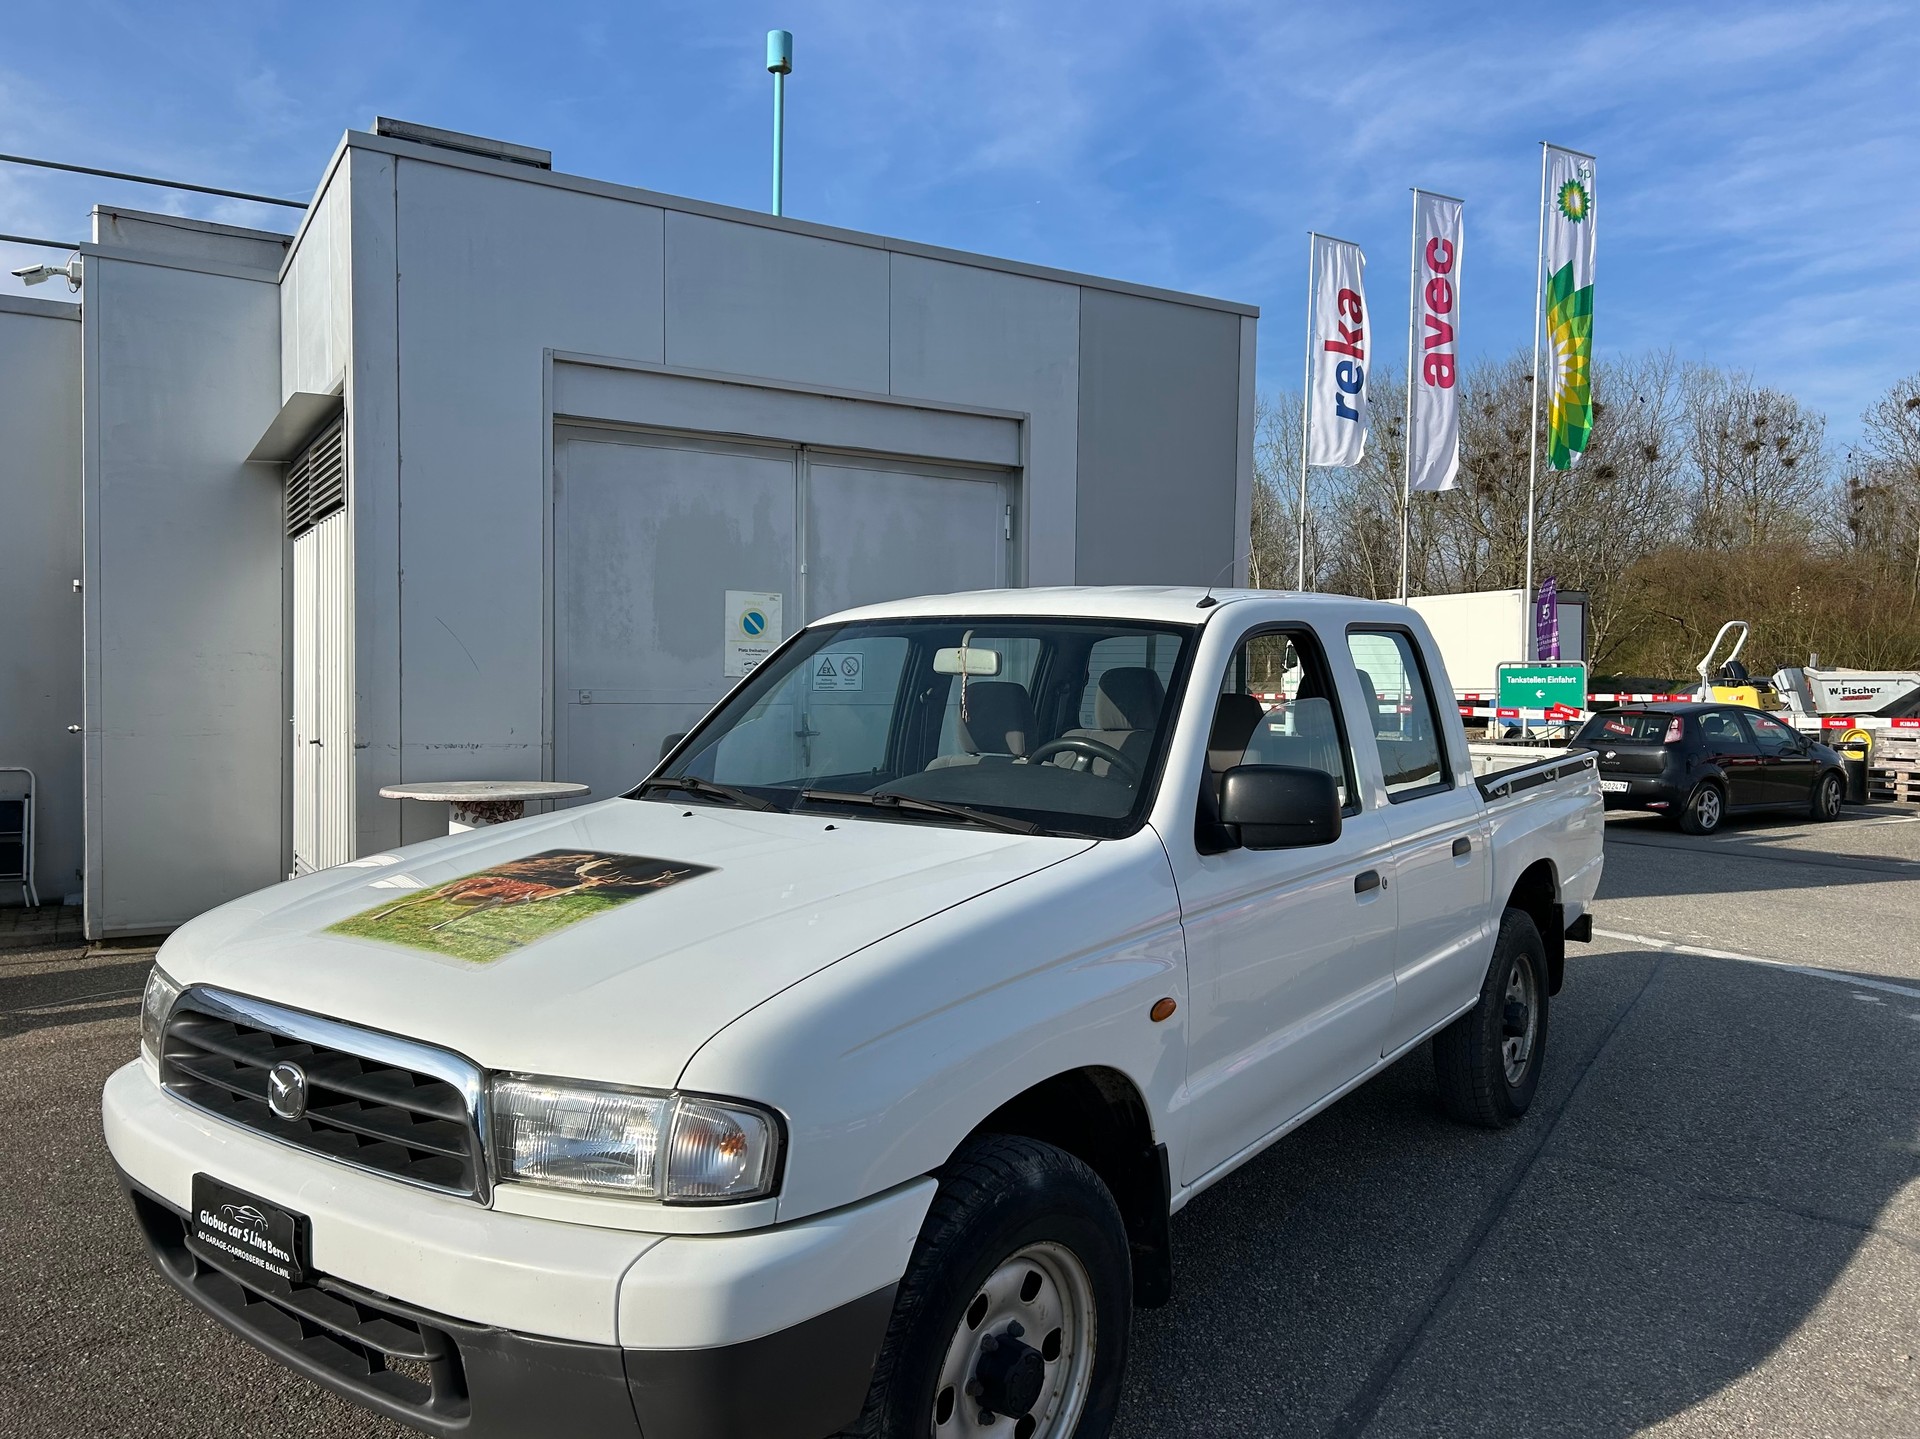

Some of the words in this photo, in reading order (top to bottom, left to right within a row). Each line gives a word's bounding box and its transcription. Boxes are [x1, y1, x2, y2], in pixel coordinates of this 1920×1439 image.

[1577, 164, 1592, 181] bp
[1423, 237, 1456, 389] avec
[1324, 288, 1365, 423] reka
[822, 666, 831, 674] EX
[1506, 676, 1546, 684] Tankstellen
[1547, 676, 1577, 684] Einfahrt
[1611, 723, 1625, 732] KIBAG
[200, 1210, 227, 1233] Globus
[228, 1224, 242, 1239] car
[243, 1228, 249, 1242] S
[249, 1230, 267, 1251] Line
[267, 1240, 290, 1262] Berro
[198, 1231, 205, 1240] AD
[205, 1234, 265, 1268] GARAGE-CARROSSERIE
[265, 1261, 290, 1279] BALLWIL
